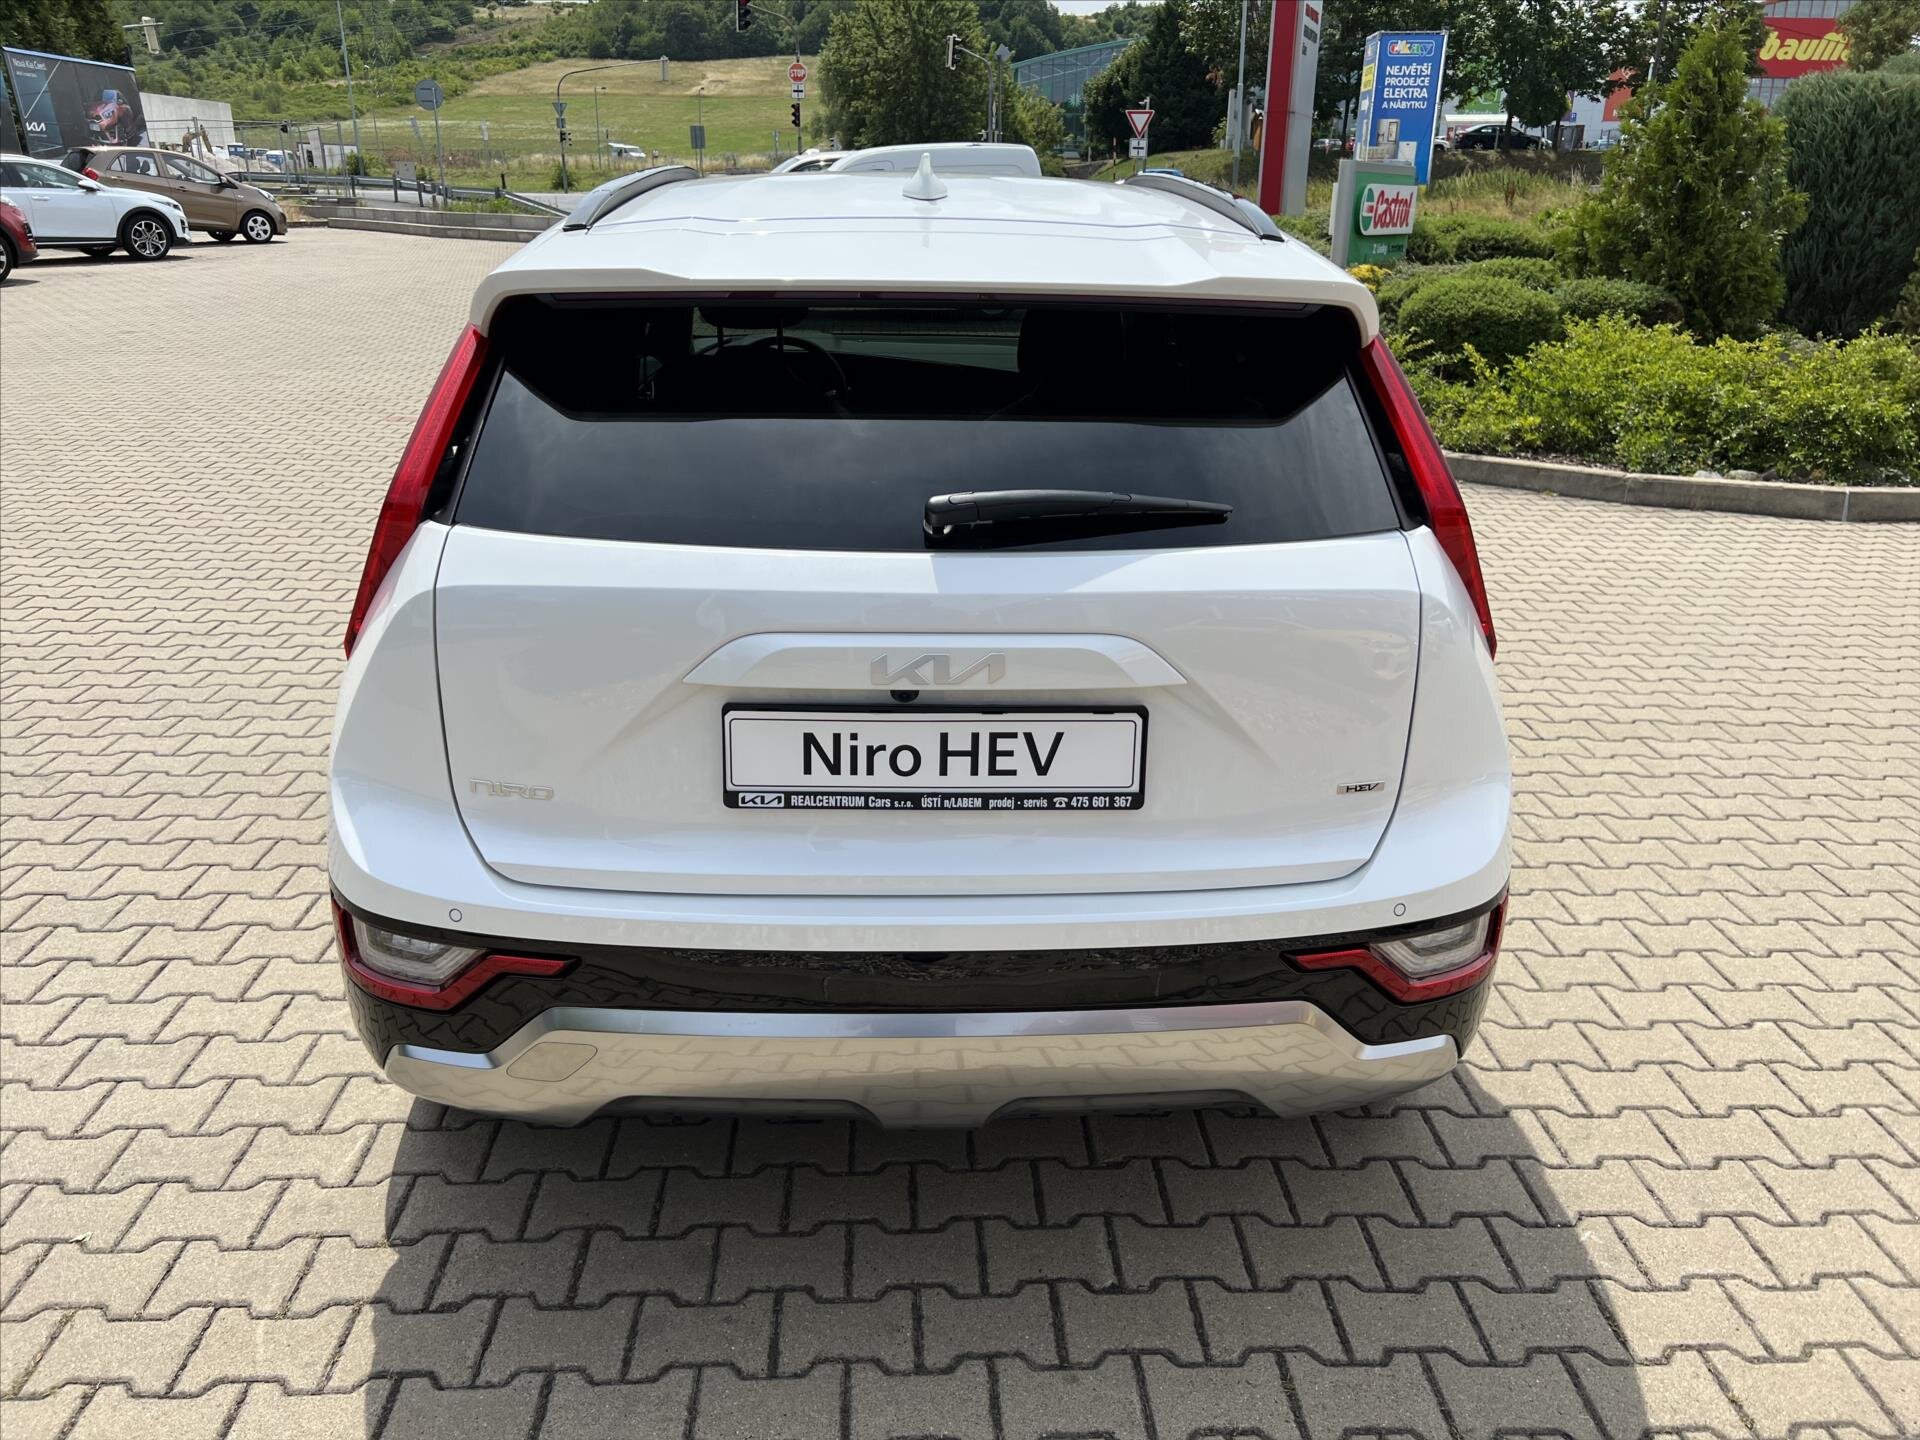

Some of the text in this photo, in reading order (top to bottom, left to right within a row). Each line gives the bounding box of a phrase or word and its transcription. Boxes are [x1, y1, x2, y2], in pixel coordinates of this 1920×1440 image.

[790, 68, 805, 78] STOP
[1386, 63, 1432, 76] NEJVĚTŠÍ
[1384, 77, 1430, 86] PRODEJCE
[1383, 87, 1428, 99] ELEKTRA
[1382, 99, 1427, 109] A NÁBYTKU
[26, 121, 46, 132] KIA
[1373, 190, 1414, 230] Castrol
[870, 652, 1006, 686] KIA
[803, 731, 1065, 777] Niro HEV
[469, 778, 554, 801] NIRO
[1345, 782, 1380, 793] HEV
[740, 794, 1132, 810] KIA REALCENTRUM Cars s.r.o. ÚSTÍ n/LABEM prodej servis 475 601 367
